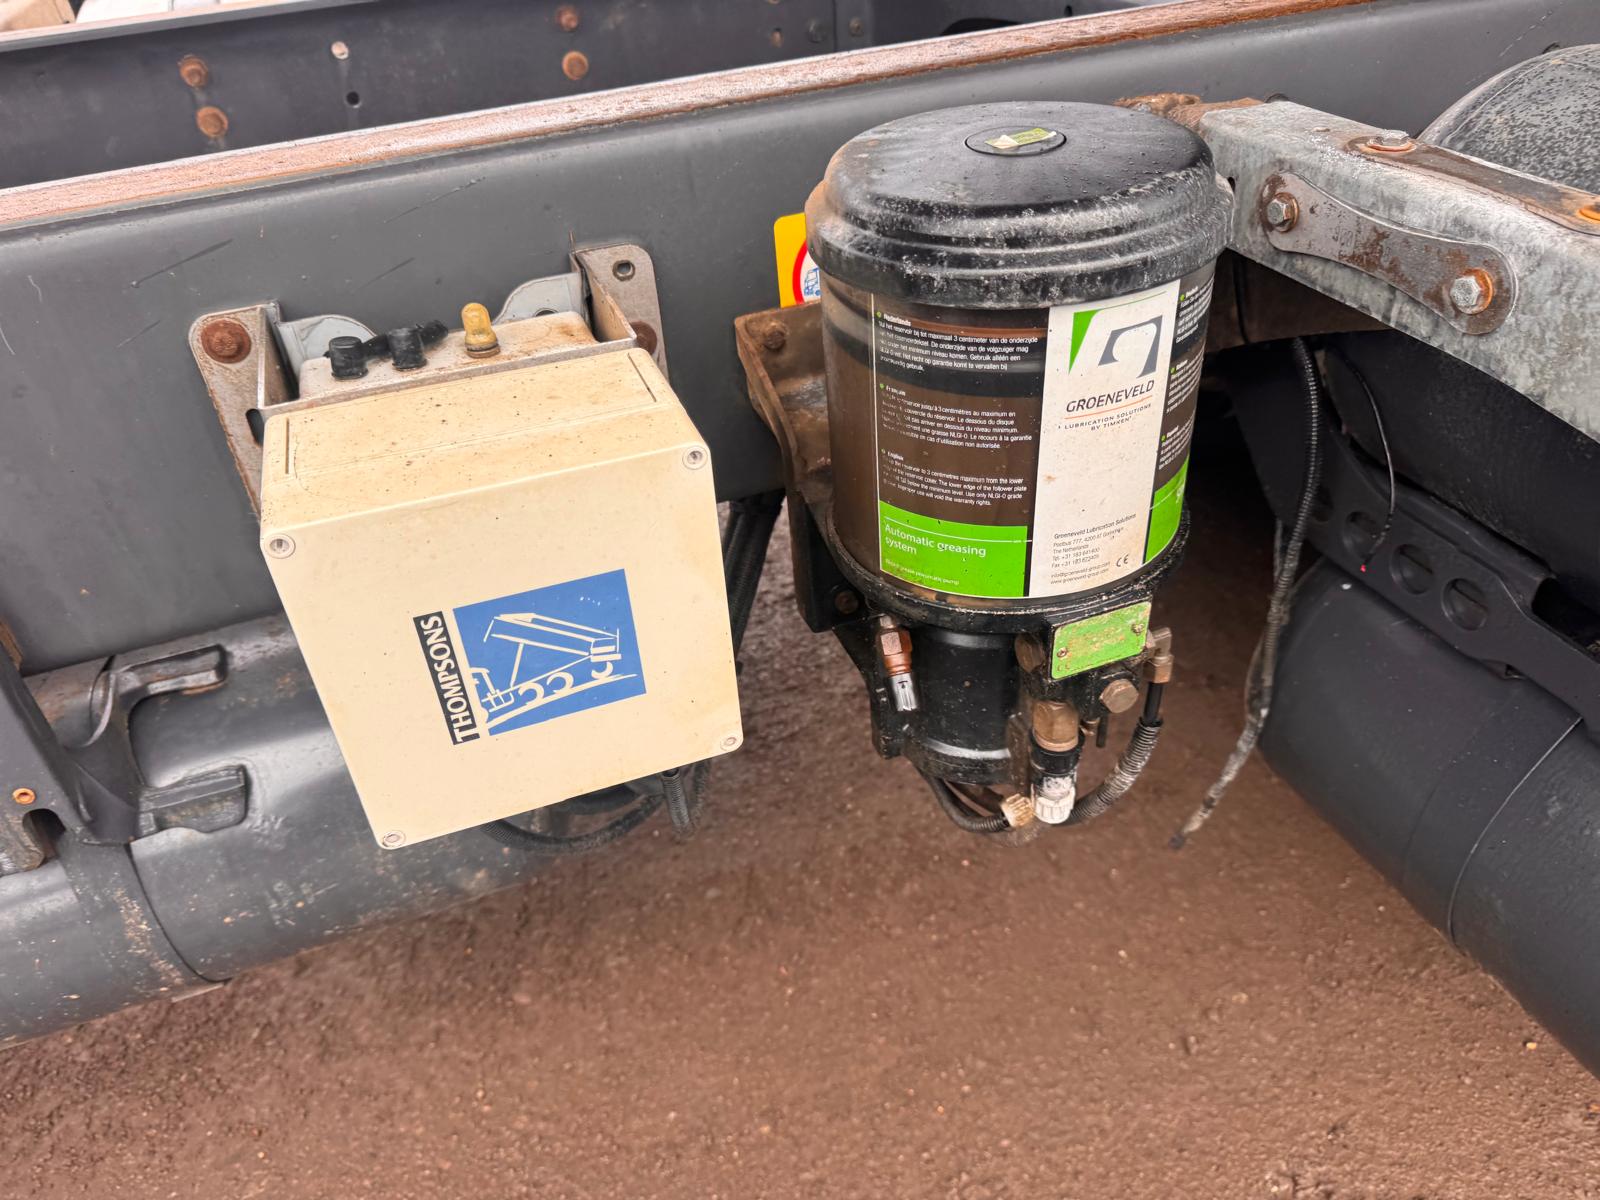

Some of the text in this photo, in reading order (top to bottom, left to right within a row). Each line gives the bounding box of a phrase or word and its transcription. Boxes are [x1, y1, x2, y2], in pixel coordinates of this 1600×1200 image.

[1066, 380, 1154, 412] GROENEVELD
[1064, 403, 1152, 430] LUBRICATION SOLUTIONS
[885, 524, 986, 558] Automatic greasing
[1054, 513, 1136, 540] Groeneveld Lubrication Solutions
[885, 536, 917, 555] system
[420, 614, 480, 744] THOMPSONS
